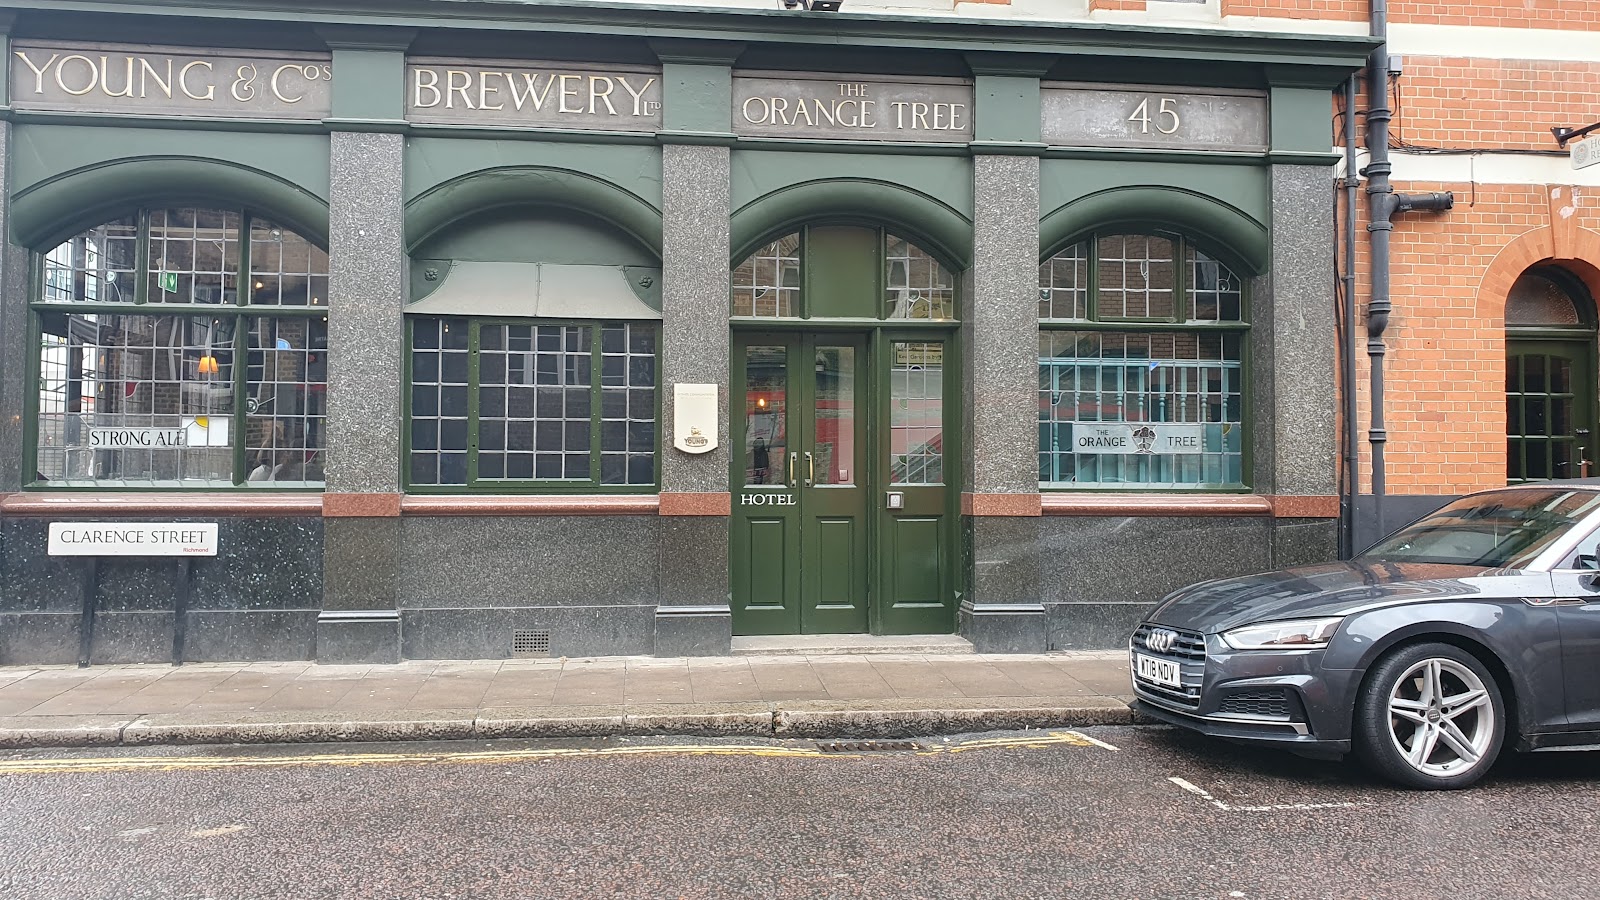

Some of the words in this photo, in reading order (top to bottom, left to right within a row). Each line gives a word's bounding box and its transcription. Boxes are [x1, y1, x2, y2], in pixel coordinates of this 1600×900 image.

[14, 52, 215, 101] YOUNG
[231, 63, 257, 102] &
[413, 68, 655, 116] BREWERY
[837, 83, 869, 97] THE
[742, 96, 877, 128] ORANGE
[890, 101, 966, 130] TREE
[1127, 97, 1180, 134] 45
[91, 430, 151, 446] STRONG
[155, 430, 185, 446] ALE
[1078, 436, 1126, 447] ORANGE
[1167, 436, 1197, 447] TREE
[740, 493, 797, 506] HOTEL
[60, 530, 144, 544] CLARENCE
[150, 530, 207, 544] STREET
